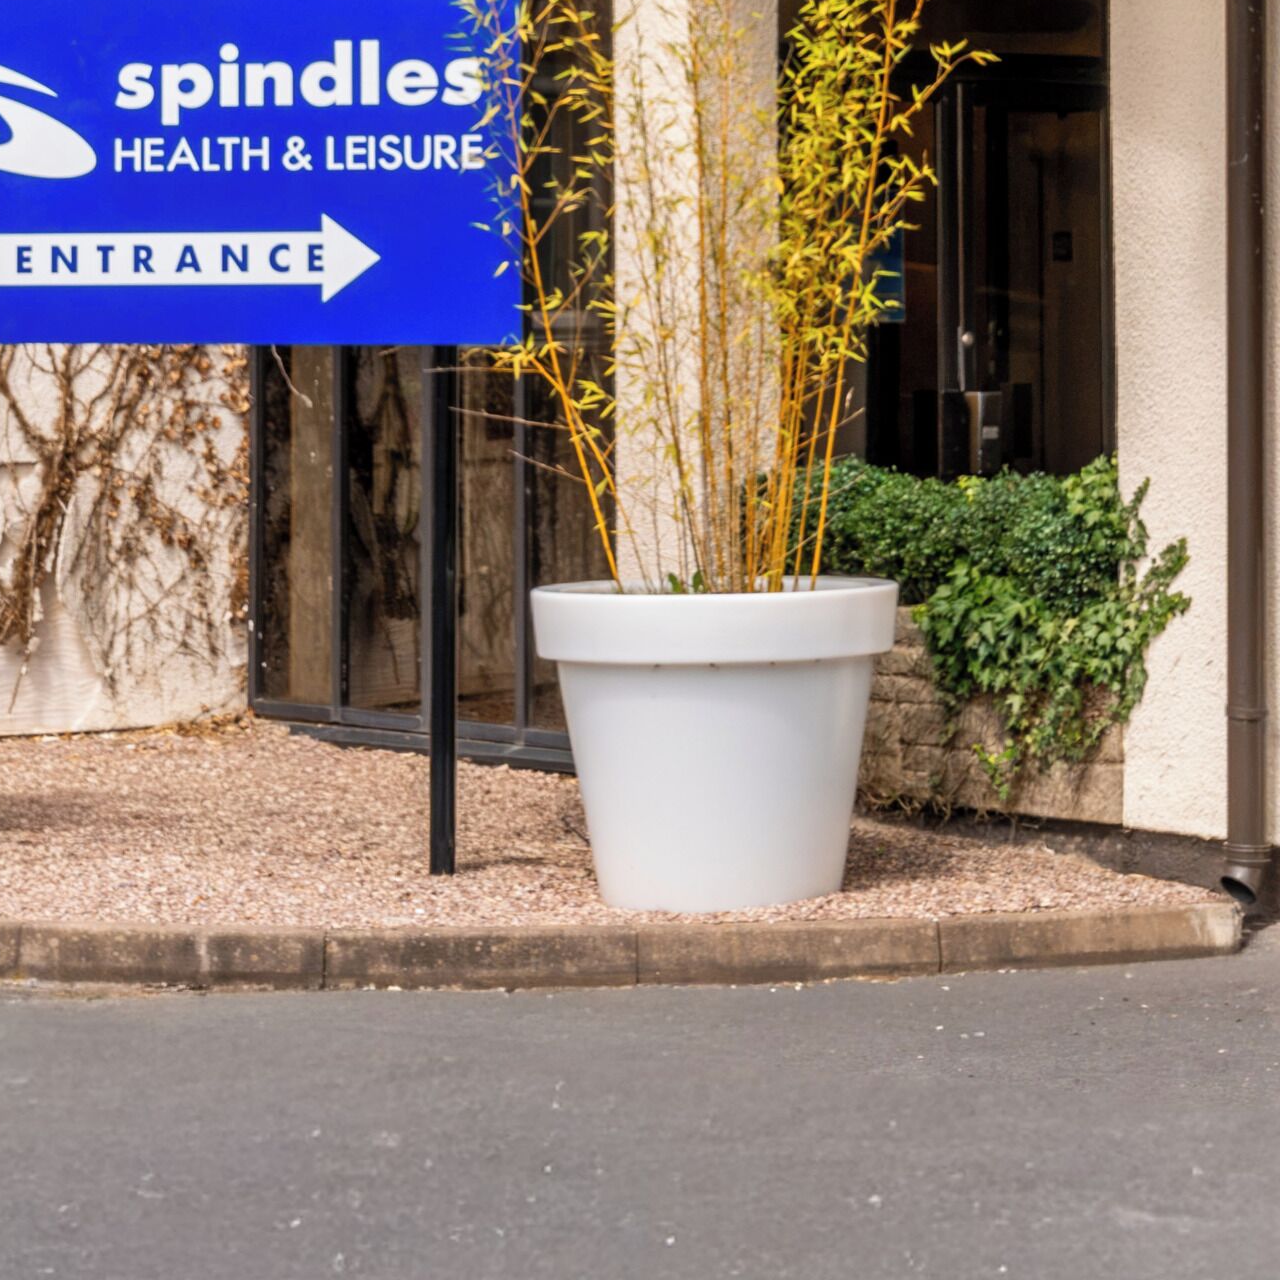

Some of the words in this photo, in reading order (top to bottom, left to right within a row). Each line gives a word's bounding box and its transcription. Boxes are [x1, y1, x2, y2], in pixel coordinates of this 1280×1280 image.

[115, 39, 483, 126] spindles
[114, 136, 270, 173] HEALTH
[281, 135, 313, 172] &
[326, 134, 485, 171] LEISURE
[16, 243, 325, 274] ENTRANCE
